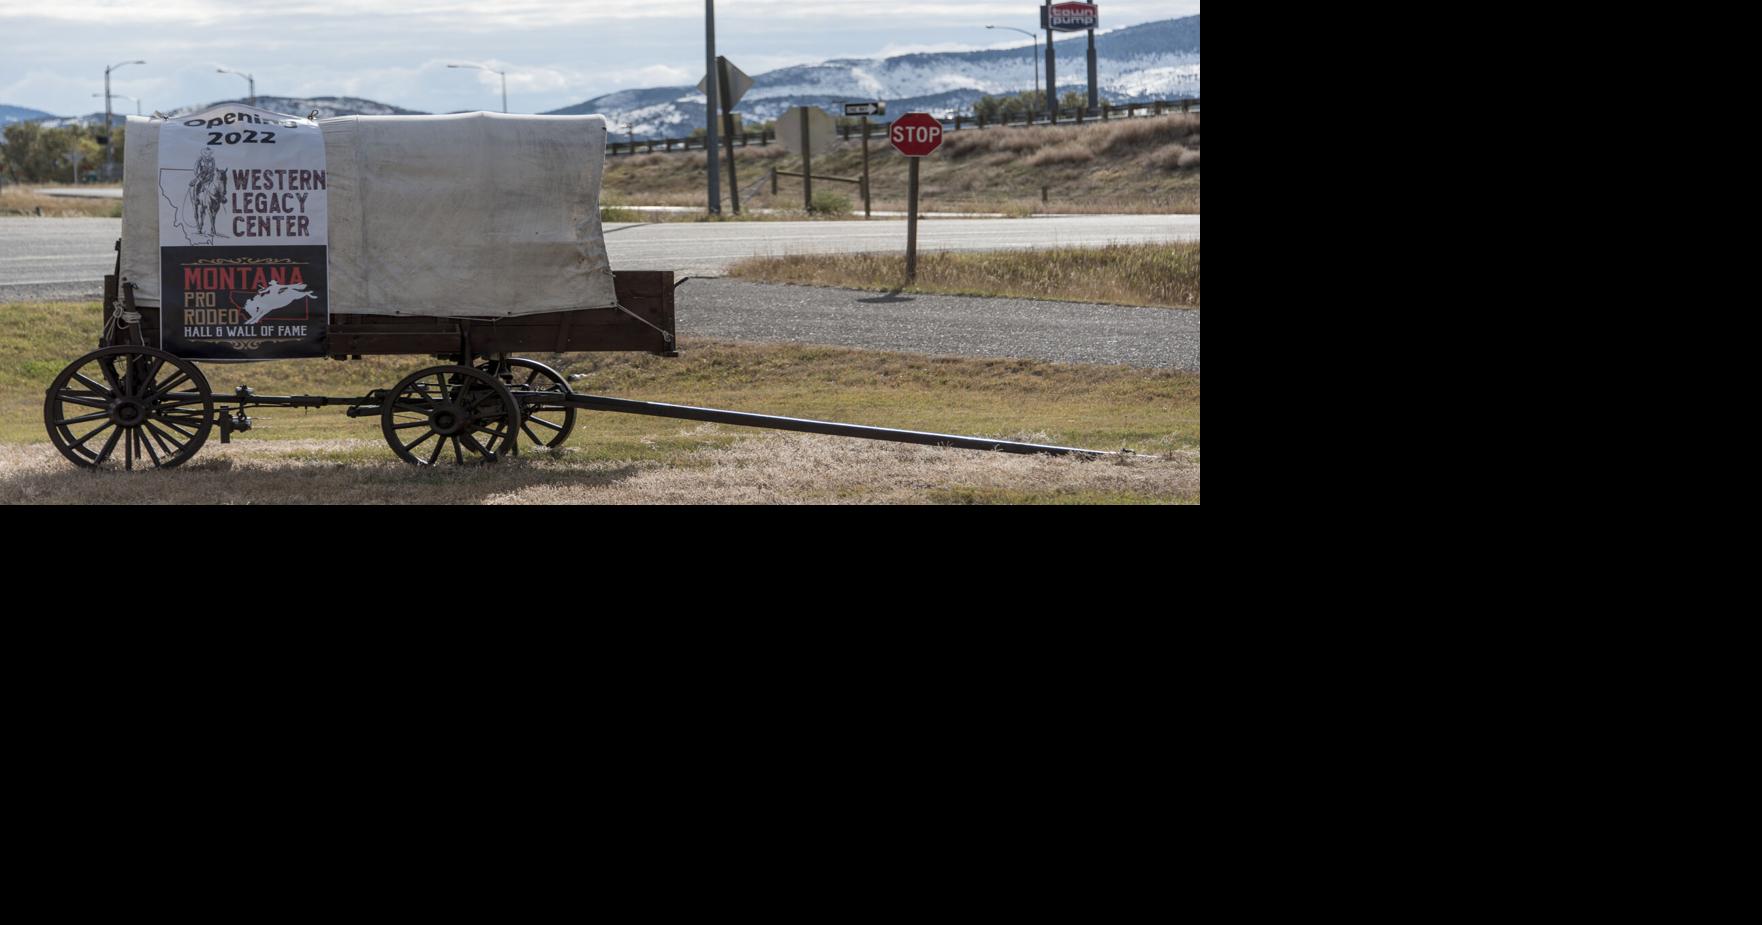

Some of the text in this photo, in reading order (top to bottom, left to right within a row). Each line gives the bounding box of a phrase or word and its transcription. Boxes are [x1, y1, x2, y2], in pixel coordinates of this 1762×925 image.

[1052, 8, 1094, 17] town
[1053, 17, 1093, 25] pump
[207, 130, 276, 145] 2022
[893, 126, 940, 143] STOP
[232, 169, 326, 190] WESTERN
[232, 193, 309, 214] LEGACY
[232, 216, 310, 237] CENTER
[184, 267, 304, 290] MONTANA
[184, 292, 216, 308] PRO
[184, 309, 240, 325] RODEO
[184, 327, 212, 337] HALL
[226, 327, 257, 337] WALL
[261, 326, 272, 336] OF
[278, 326, 307, 336] FAME
